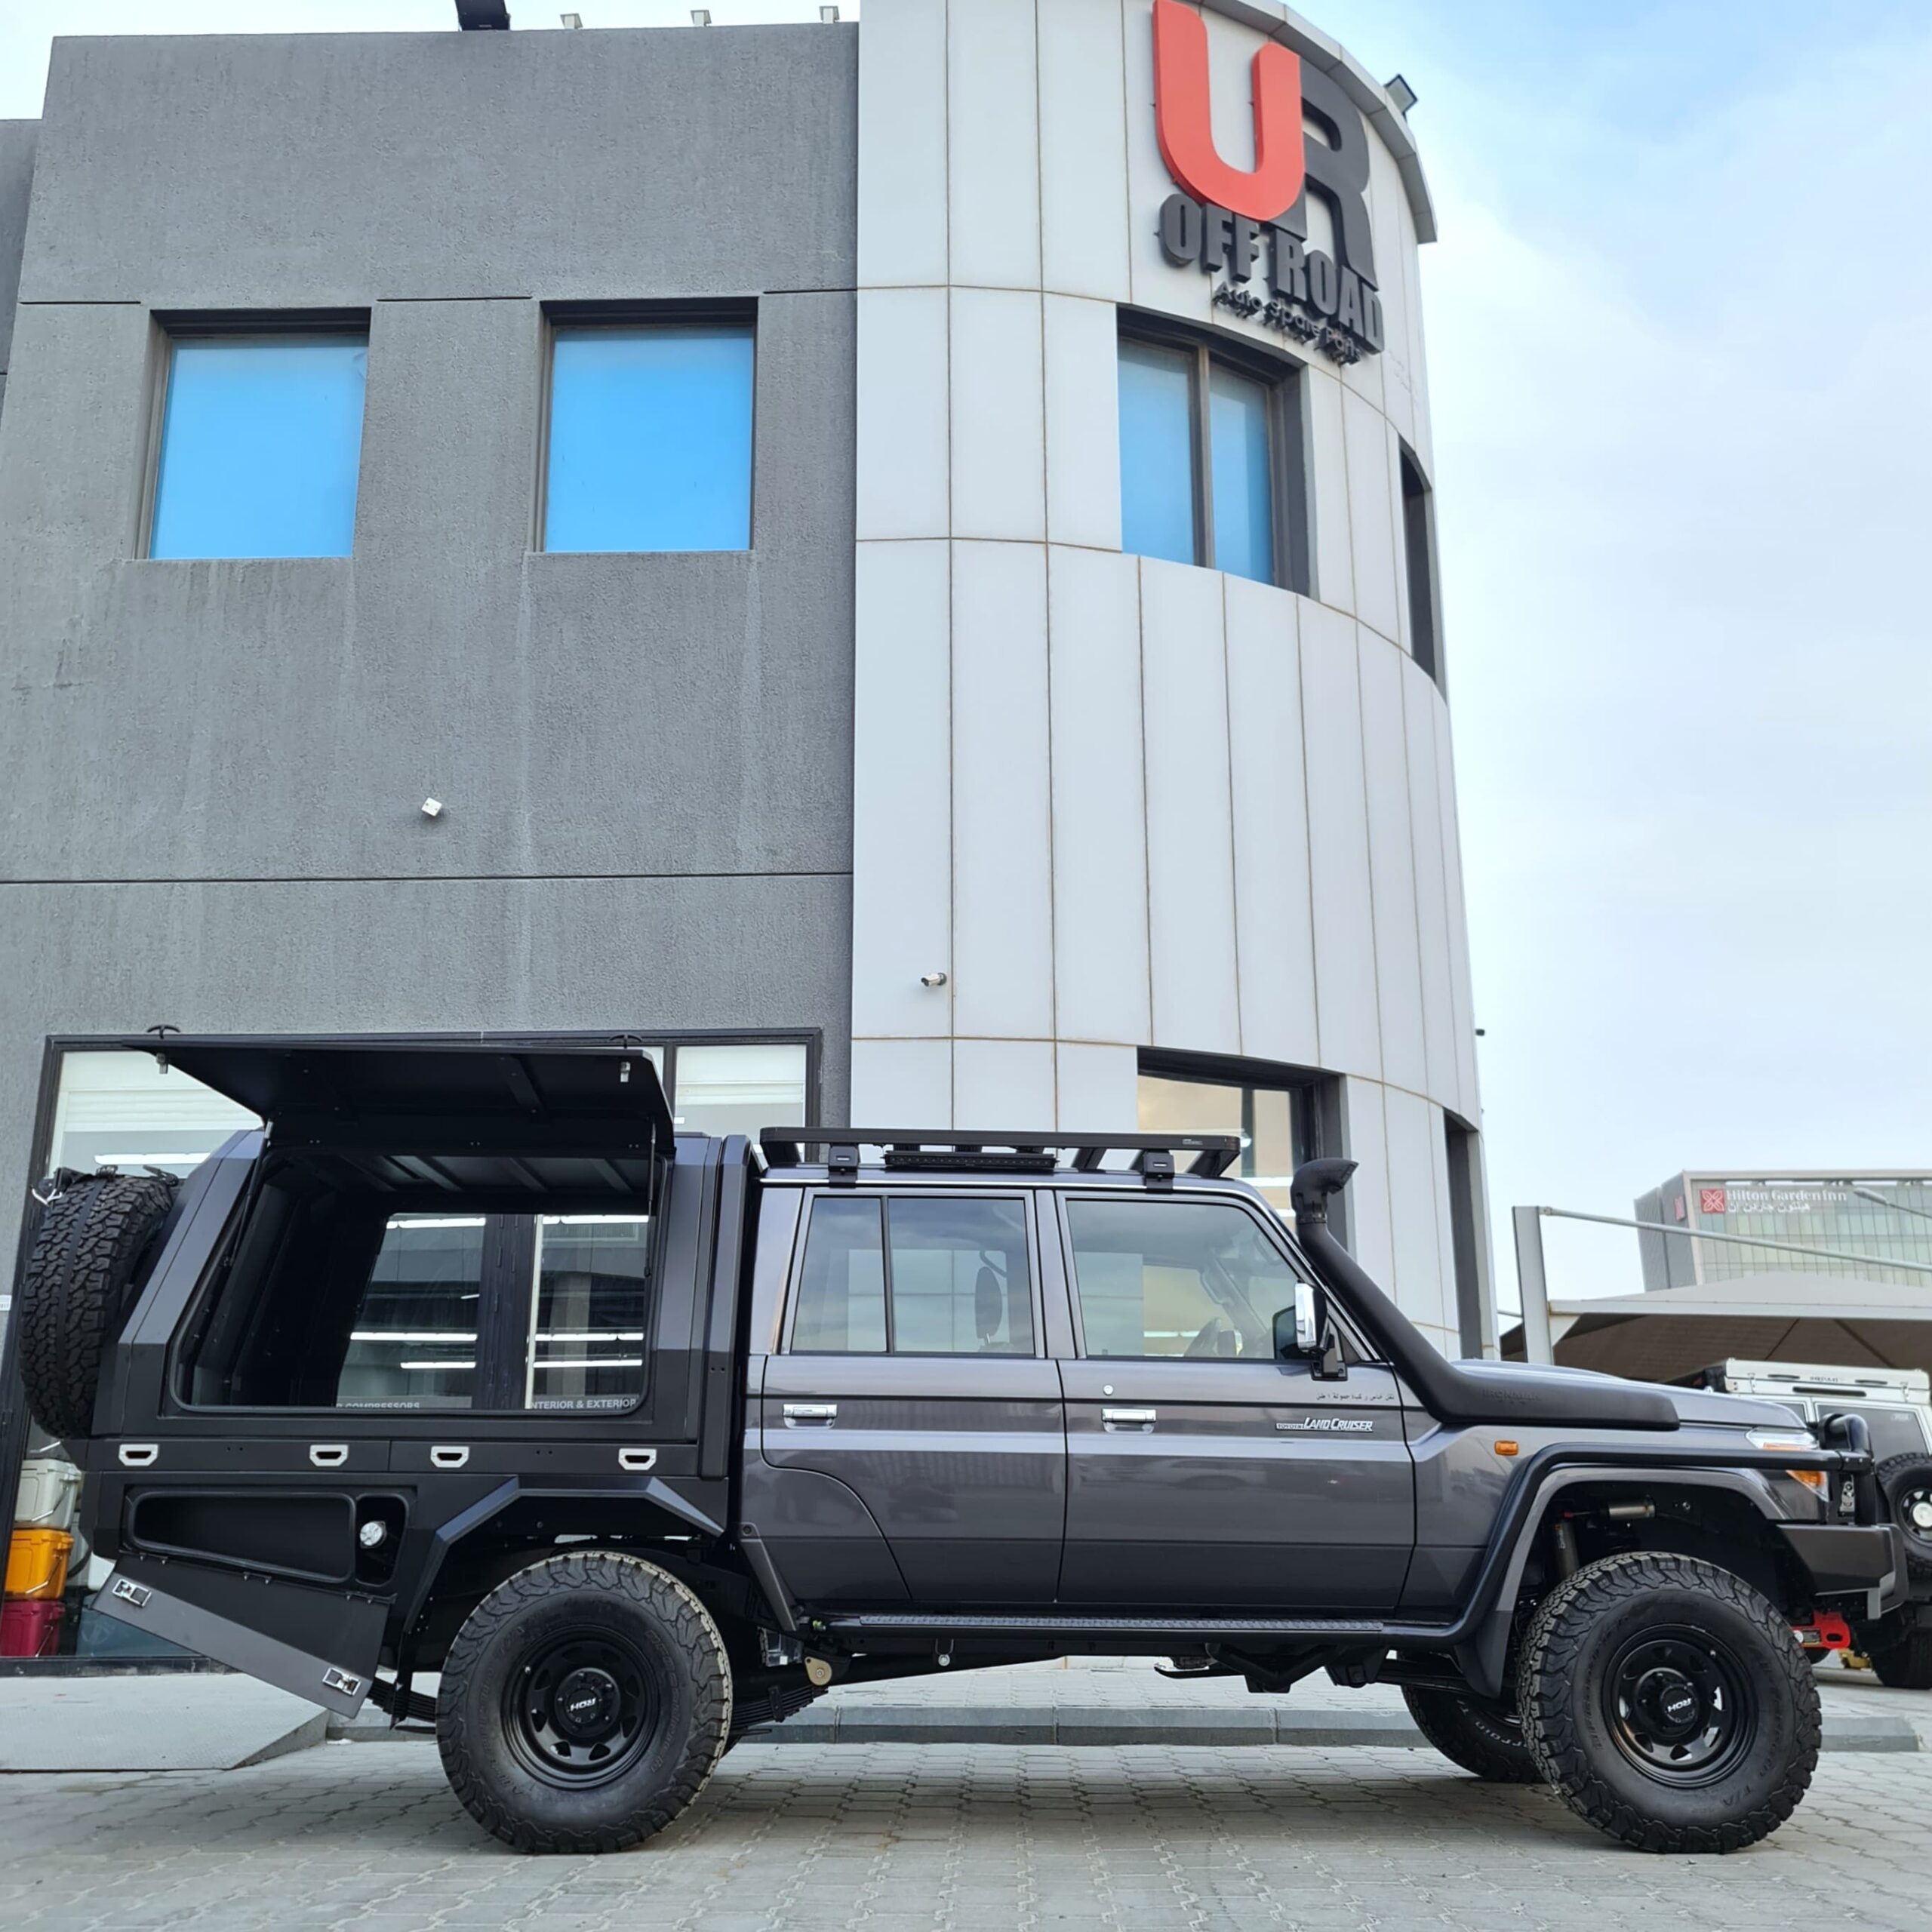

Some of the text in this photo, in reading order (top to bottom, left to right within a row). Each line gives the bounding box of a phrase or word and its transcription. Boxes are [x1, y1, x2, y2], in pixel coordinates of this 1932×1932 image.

[1160, 193, 1385, 354] OFF ROAD
[1211, 281, 1263, 312] Auto
[1726, 1189, 1847, 1201] Hilton Garden Inn
[531, 1401, 574, 1409] NTERIOR
[576, 1400, 584, 1408] &
[1303, 1417, 1331, 1429] LAND
[1331, 1418, 1374, 1432] CRUISER
